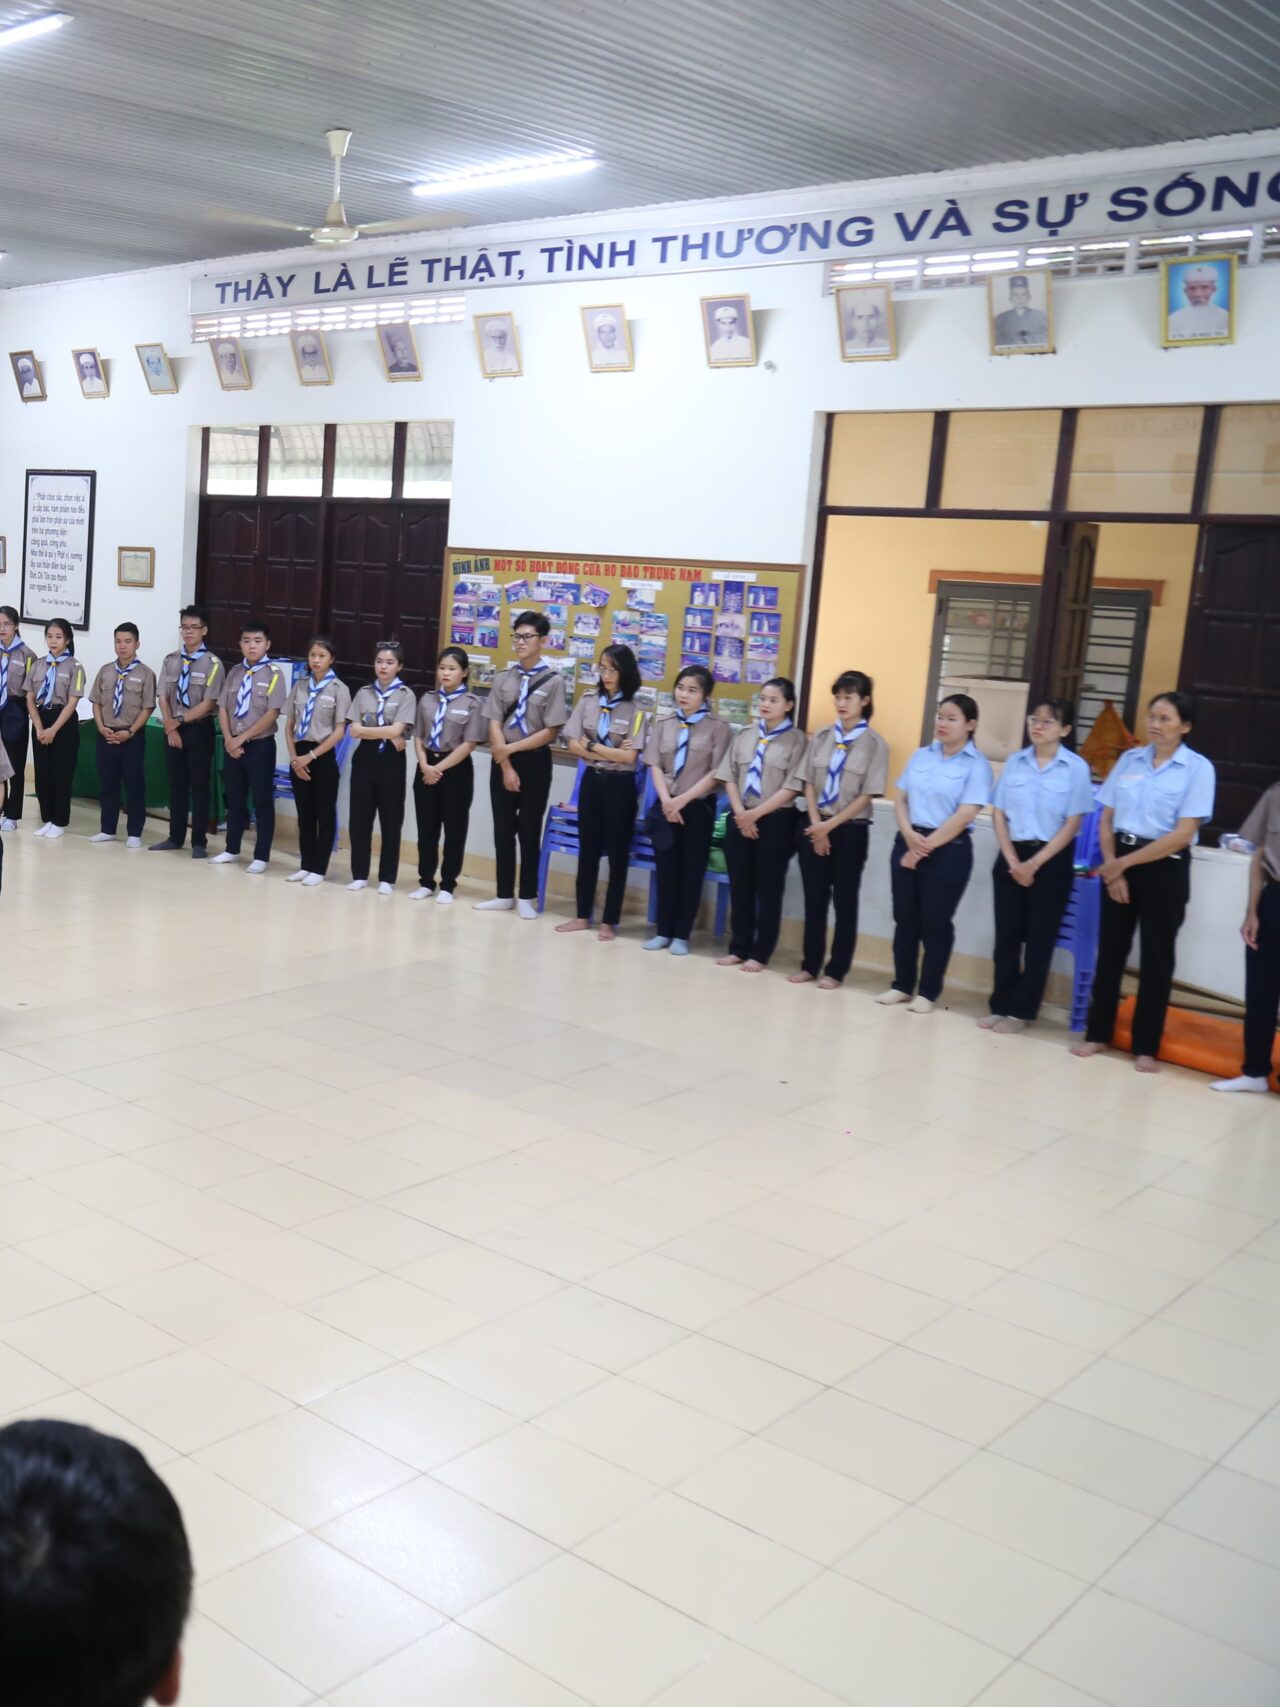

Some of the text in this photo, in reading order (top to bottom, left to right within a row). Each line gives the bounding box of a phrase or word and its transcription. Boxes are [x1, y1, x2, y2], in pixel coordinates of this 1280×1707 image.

[215, 272, 296, 304] THẦY
[314, 263, 355, 294] LÀ
[367, 256, 408, 289] LẼ
[421, 248, 525, 282] THẬT,
[540, 239, 636, 273] TÌNH
[652, 216, 874, 263] THƯƠNG
[894, 199, 973, 242] VÀ
[992, 192, 1089, 237] SỰ
[643, 566, 675, 581] TRUNG
[680, 567, 702, 582] NAM
